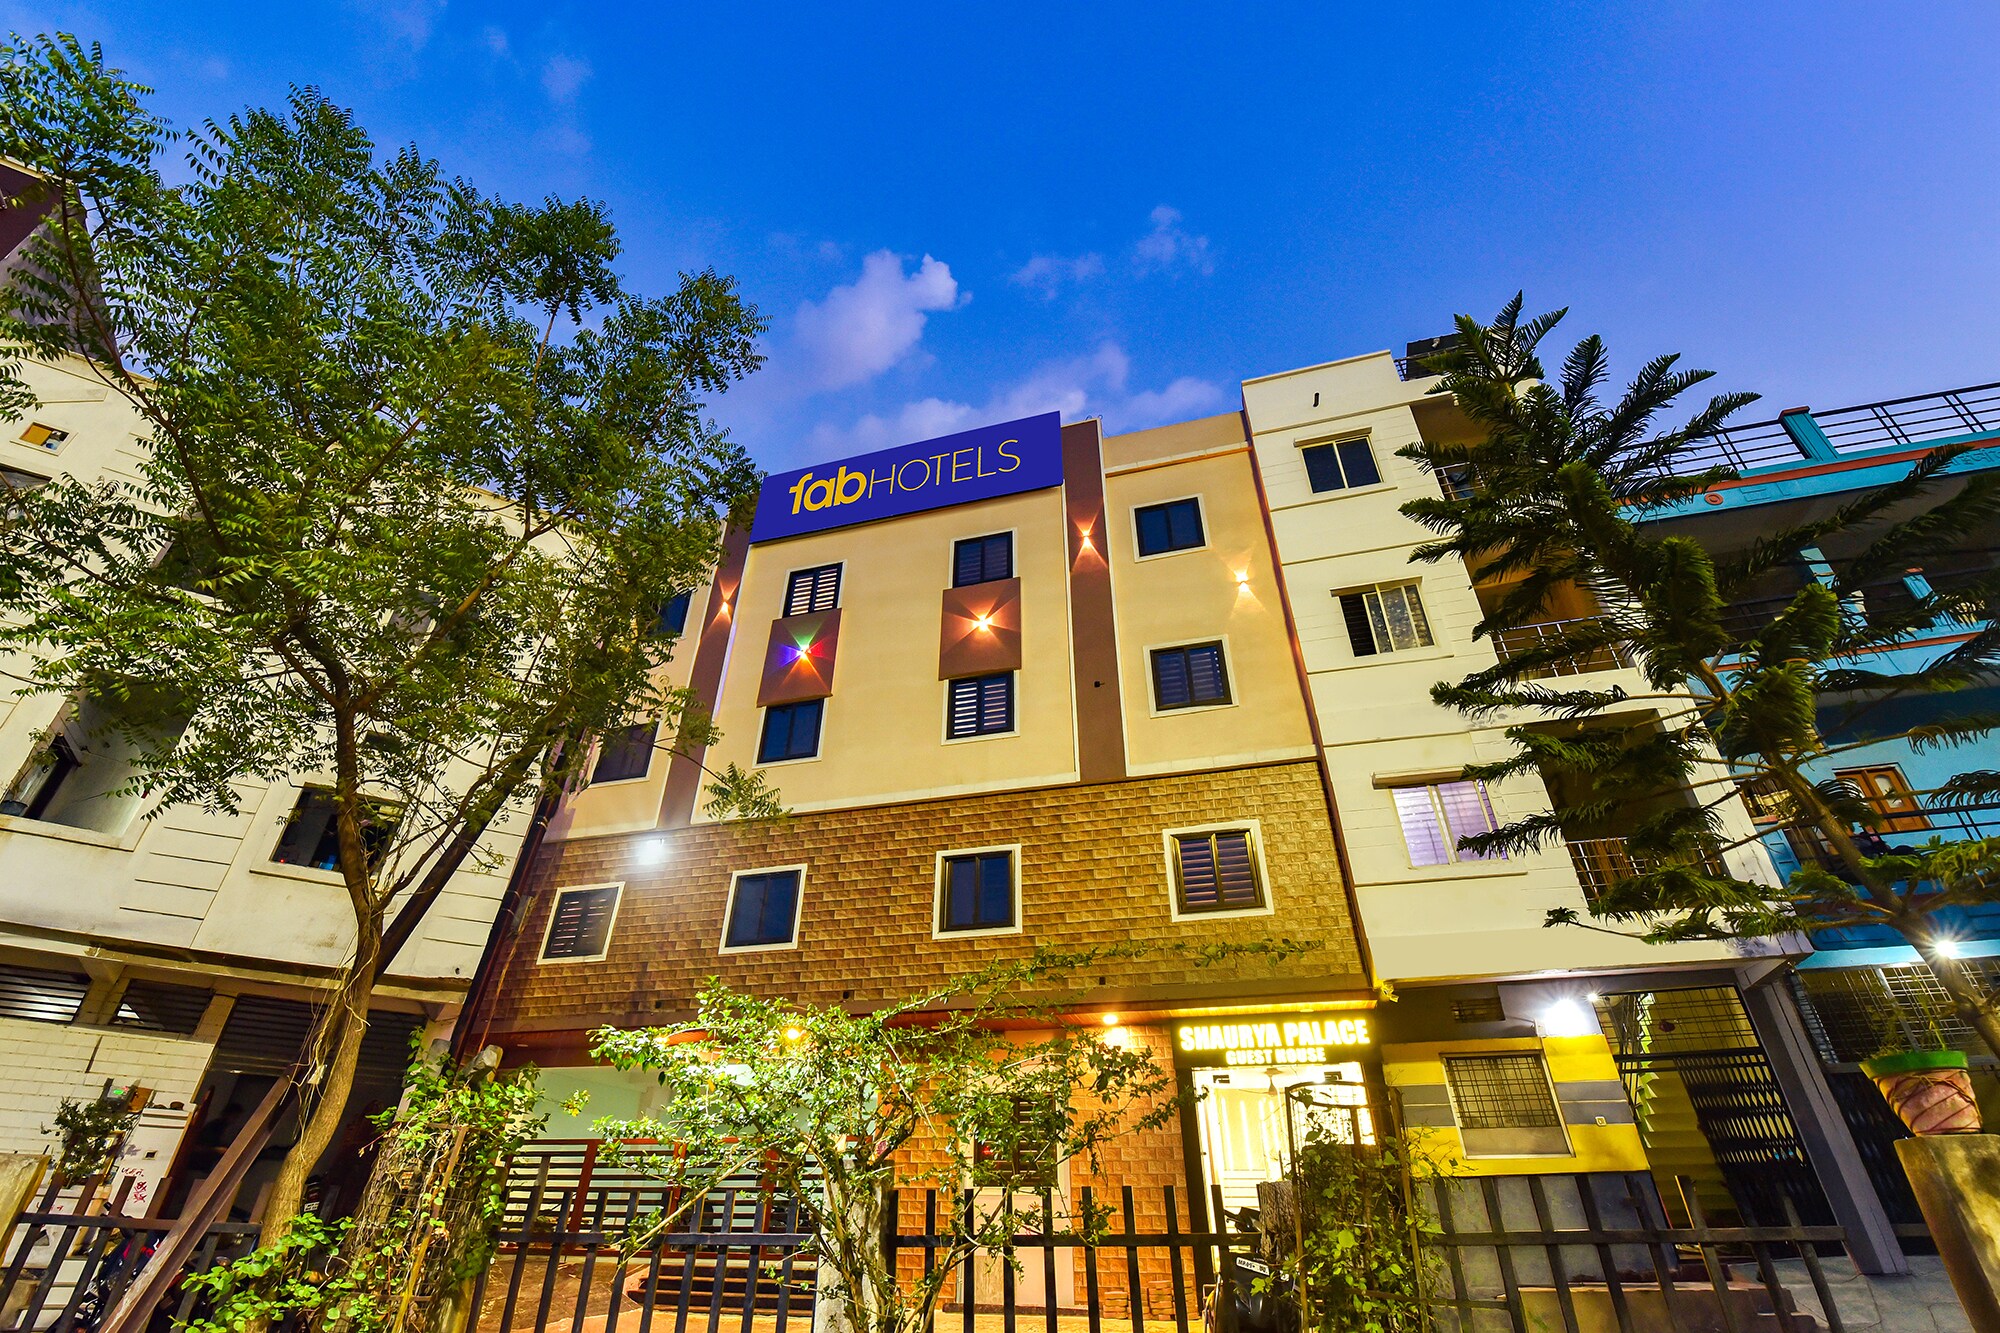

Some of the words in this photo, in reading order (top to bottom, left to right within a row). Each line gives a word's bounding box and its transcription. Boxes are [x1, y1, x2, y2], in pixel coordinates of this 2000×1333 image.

[788, 439, 1021, 514] fabHOTELS
[1179, 1021, 1283, 1051] SHAURYA
[1283, 1018, 1371, 1046] PALACE
[1225, 1048, 1273, 1066] GUEST
[1274, 1047, 1327, 1064] HOUSE
